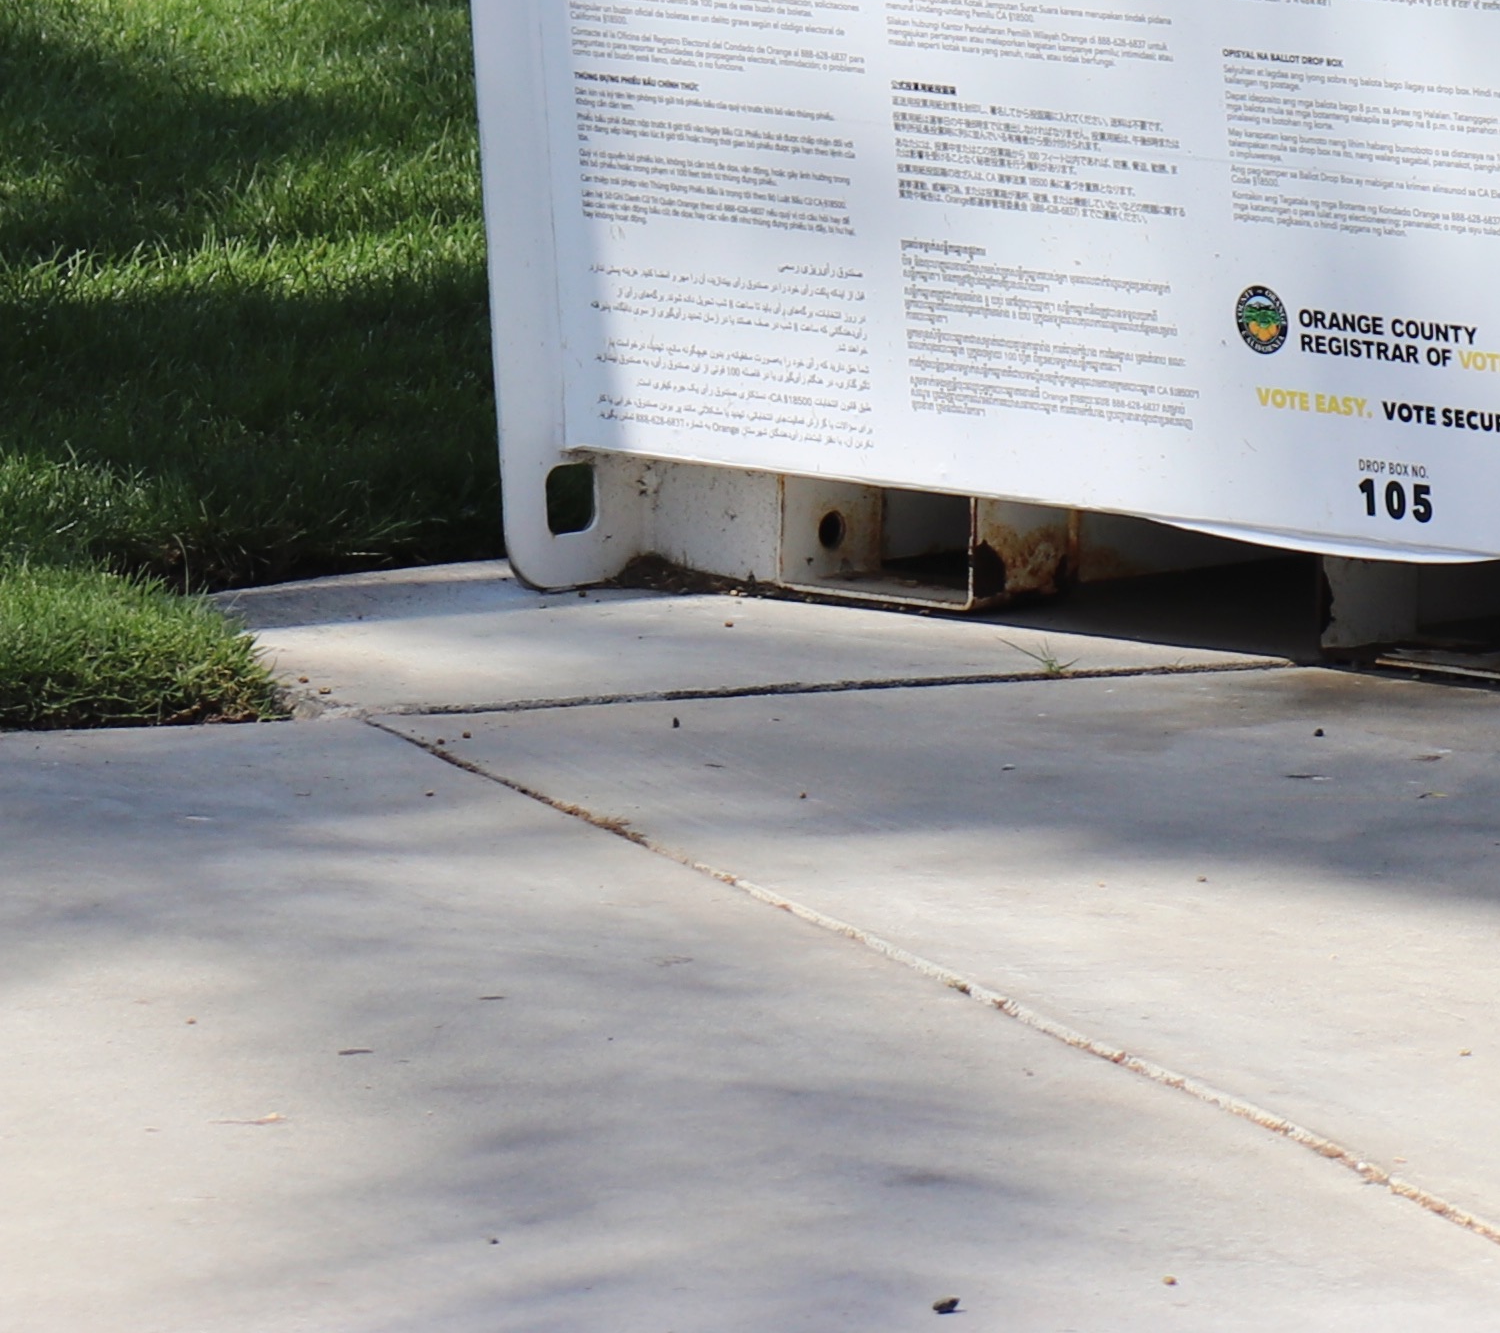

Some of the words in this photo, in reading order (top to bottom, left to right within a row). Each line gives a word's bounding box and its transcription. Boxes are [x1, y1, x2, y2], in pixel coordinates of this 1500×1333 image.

[1299, 309, 1384, 335] ORANGE
[1391, 319, 1476, 344] COUNTY
[1301, 333, 1419, 365] REGISTRAR
[1426, 346, 1453, 368] OF
[1256, 386, 1310, 412] VOTE
[1315, 391, 1374, 419] EASY.
[1382, 400, 1436, 426] VOTE
[1358, 457, 1386, 474] DROP
[1388, 461, 1409, 477] BOX
[1411, 463, 1430, 479] NO.
[1359, 479, 1432, 523] 105
